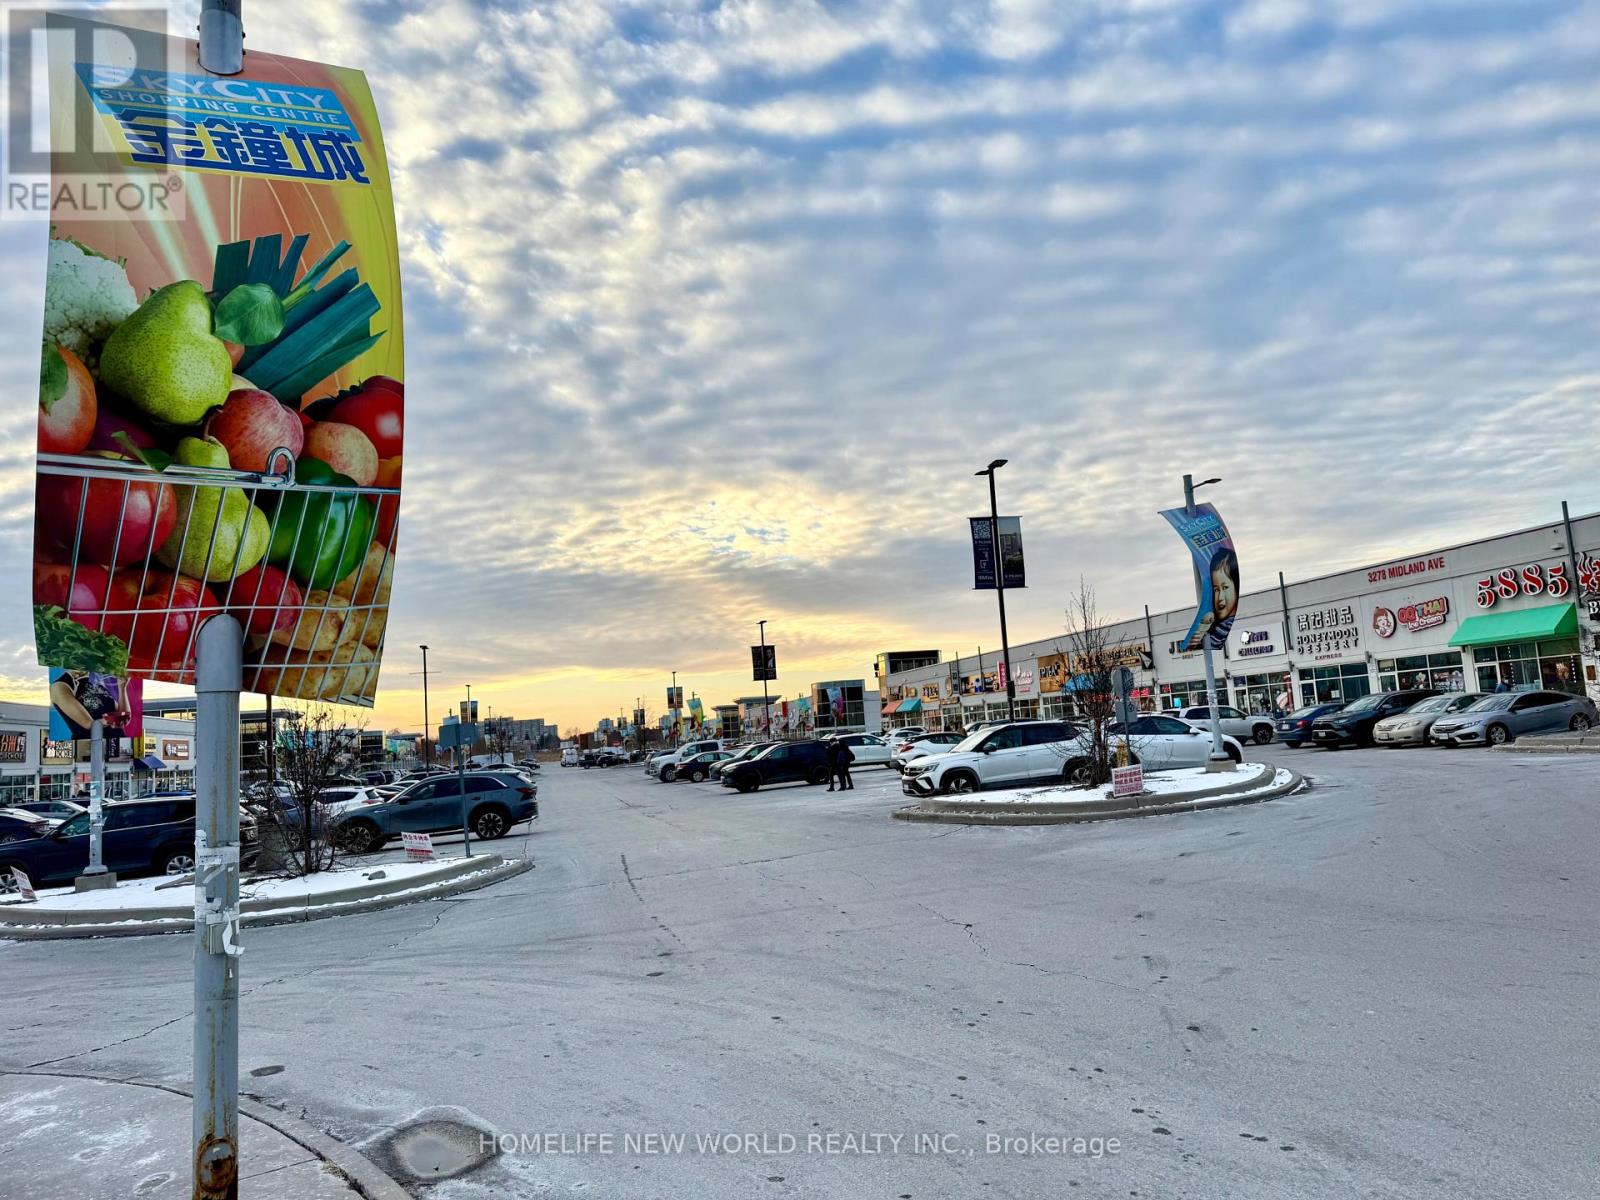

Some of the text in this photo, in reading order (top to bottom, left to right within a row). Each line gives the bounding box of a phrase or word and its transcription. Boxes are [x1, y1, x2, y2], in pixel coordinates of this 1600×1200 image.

[99, 89, 342, 125] SHOPPING CENTRE
[113, 107, 371, 185] 金鐘城
[1367, 557, 1446, 583] 3278 MIDLAND AVE
[1477, 562, 1569, 609] 5885
[1297, 627, 1359, 645] HONEYMOON
[1298, 638, 1359, 655] DESSERT
[1314, 652, 1343, 661] EXPRESS
